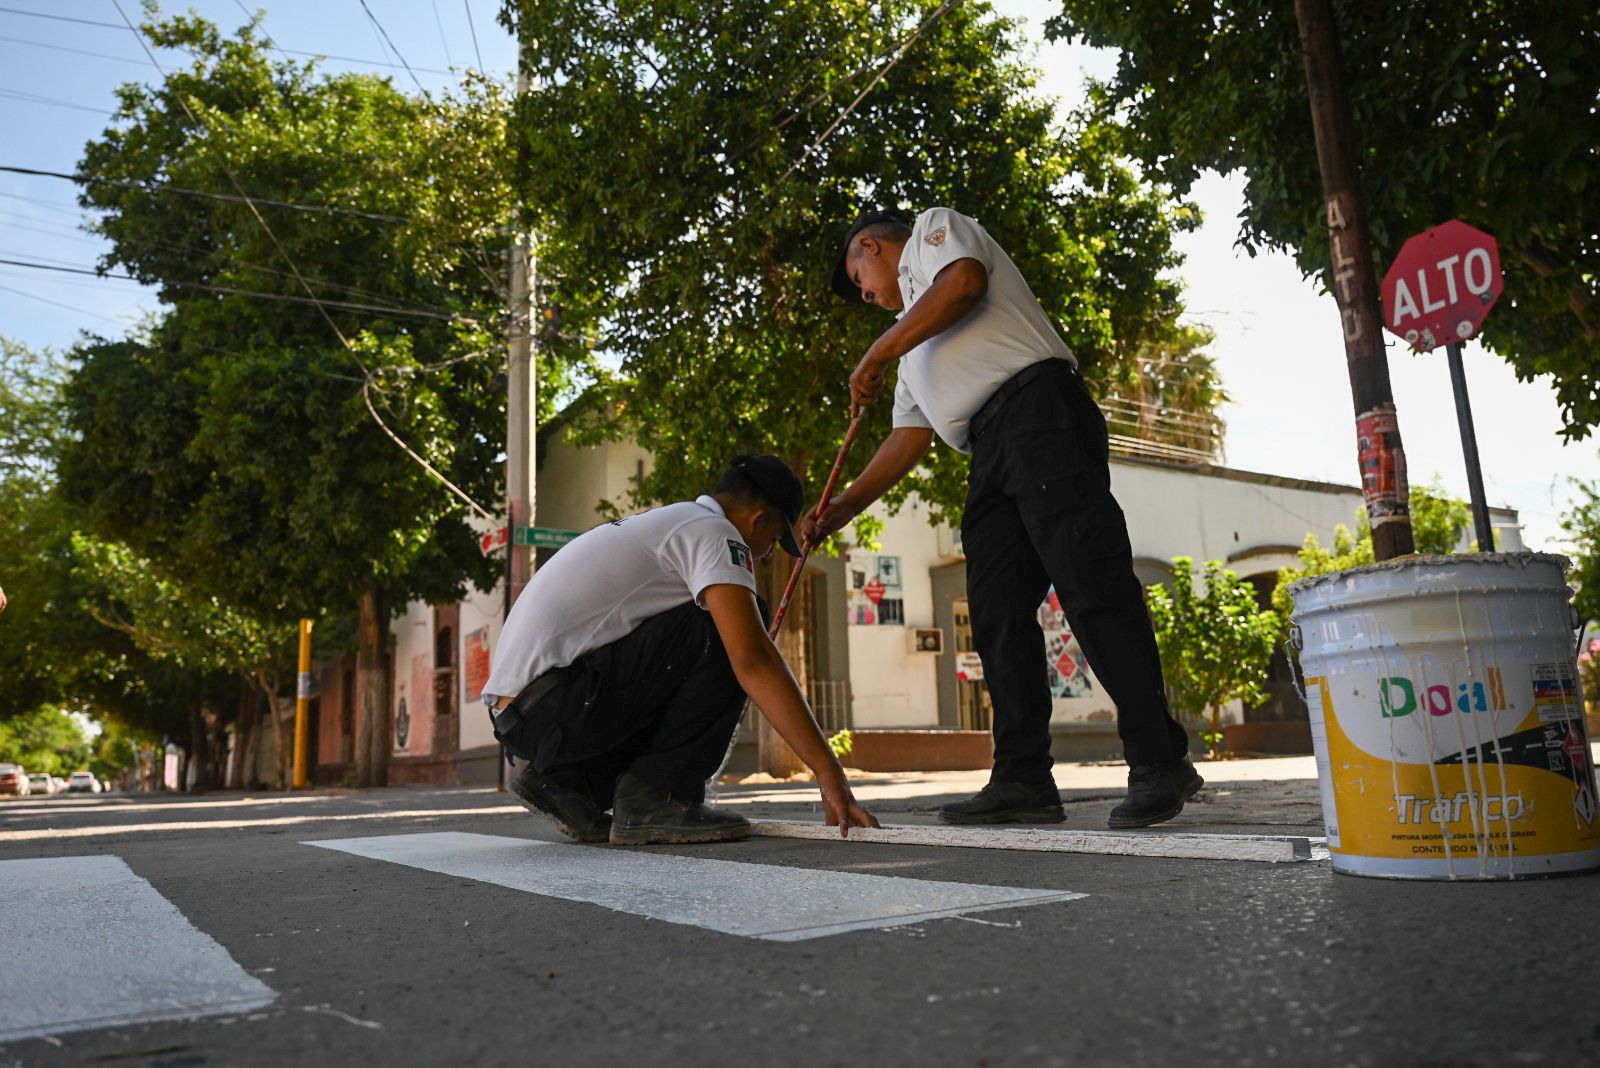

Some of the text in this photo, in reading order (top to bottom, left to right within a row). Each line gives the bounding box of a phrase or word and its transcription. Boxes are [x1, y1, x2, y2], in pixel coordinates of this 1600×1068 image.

[1328, 198, 1362, 342] ALTO
[1393, 247, 1493, 327] ALTO
[1378, 667, 1507, 718] Doal
[1391, 833, 1421, 841] PINTURA
[1502, 830, 1537, 839] CORADO
[1412, 845, 1468, 854] CONTEIDO
